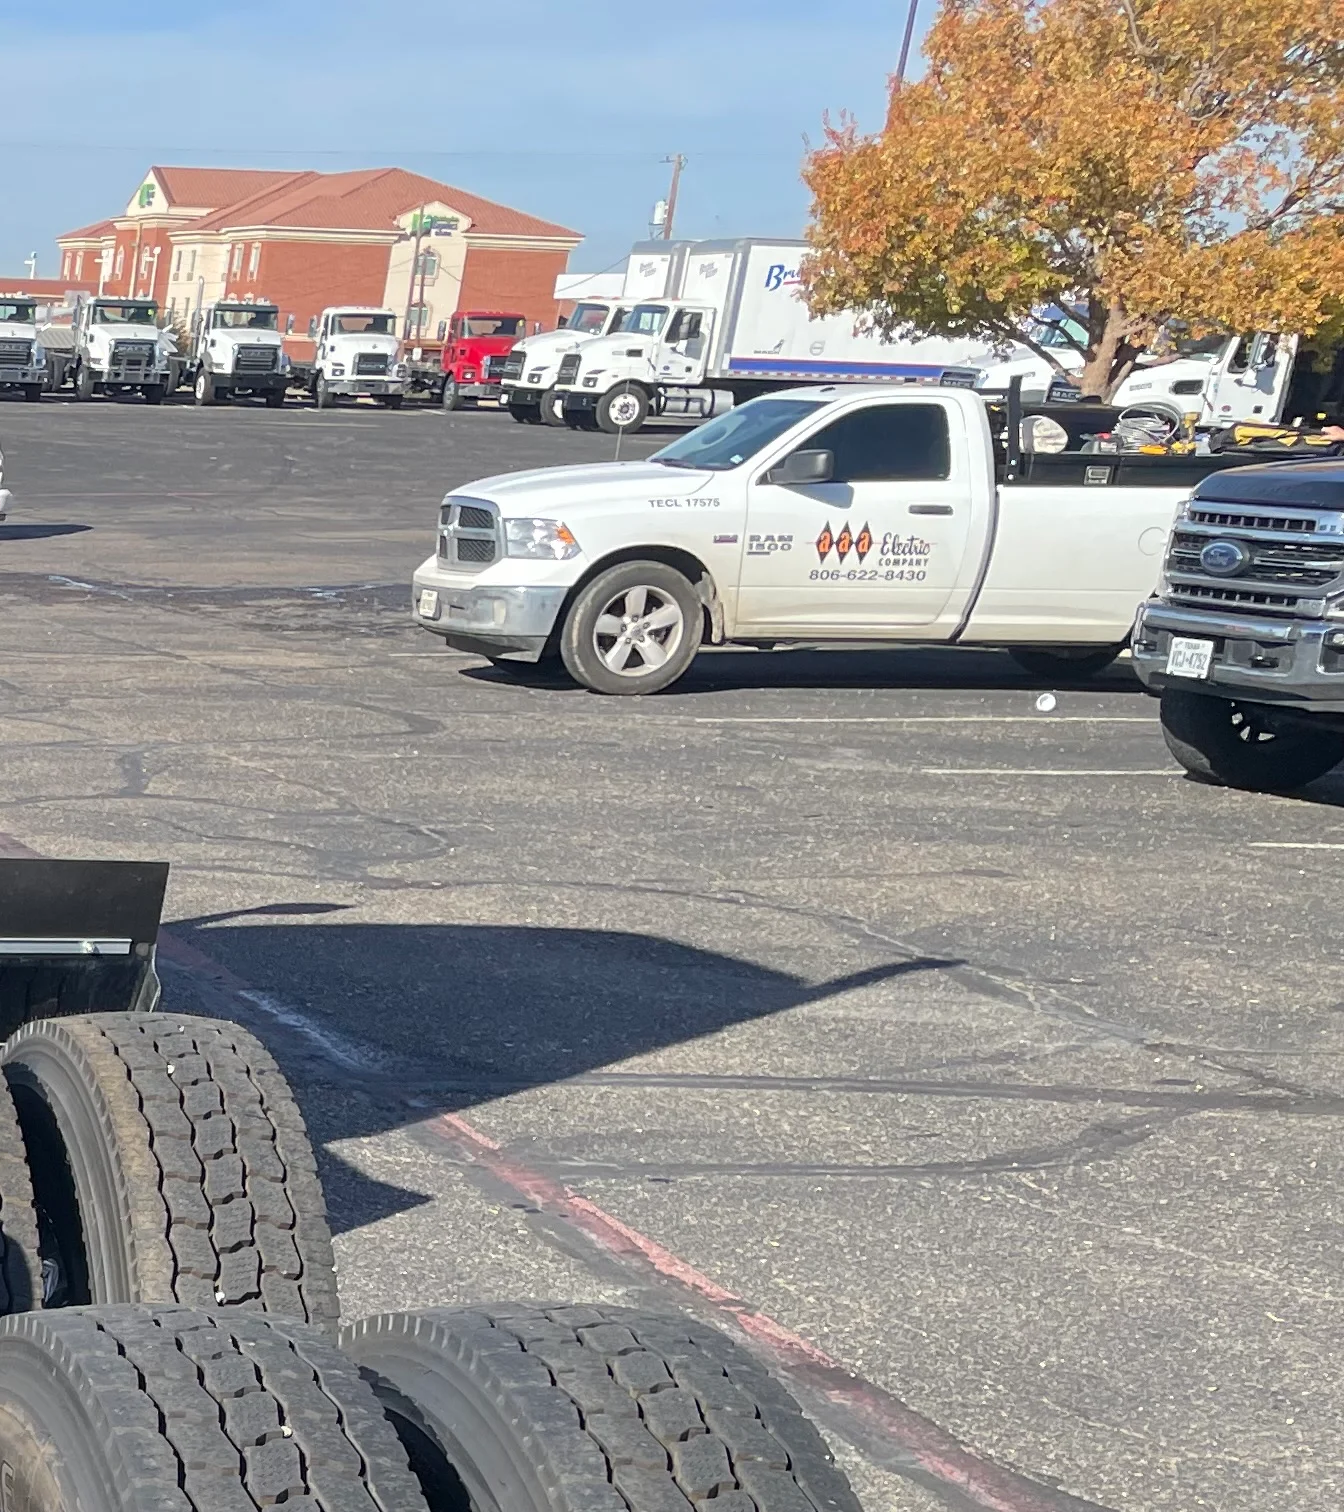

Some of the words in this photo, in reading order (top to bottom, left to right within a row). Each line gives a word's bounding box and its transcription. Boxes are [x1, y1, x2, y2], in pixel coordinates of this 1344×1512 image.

[648, 499, 682, 508] TECL
[749, 543, 792, 551] 1500
[880, 532, 930, 556] Electric
[878, 558, 929, 566] COMPANY
[809, 569, 926, 581] 806-622-8430
